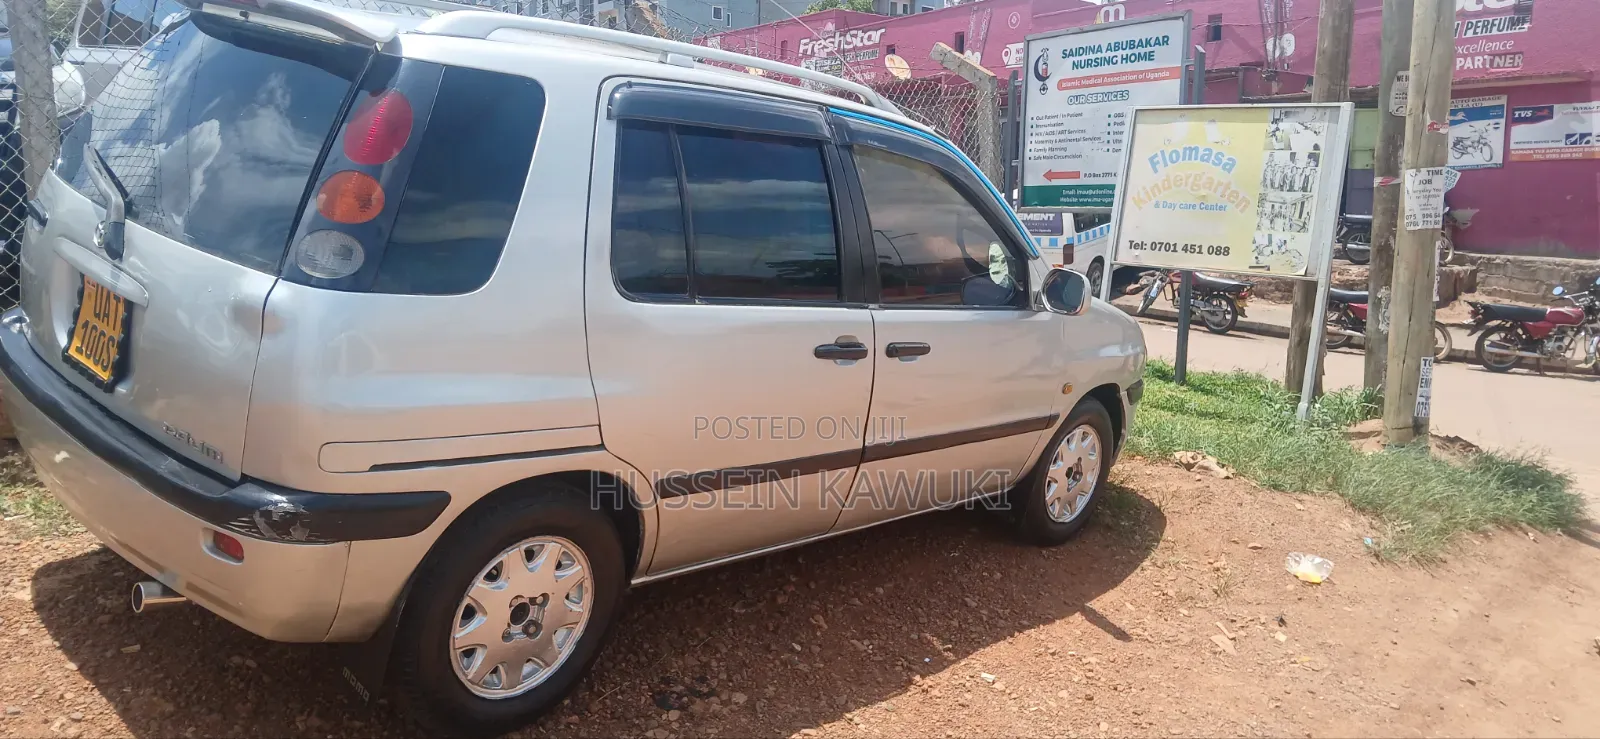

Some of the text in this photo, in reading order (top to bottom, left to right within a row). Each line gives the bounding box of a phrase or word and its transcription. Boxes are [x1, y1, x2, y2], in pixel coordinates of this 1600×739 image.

[1464, 15, 1530, 37] PERFUME
[1061, 35, 1170, 59] SAIDINA ABUBAKAR
[1072, 50, 1155, 71] NURSING HOME
[1456, 54, 1523, 70] PARTNER
[1061, 69, 1170, 88] Islamic Medical Association of Uganda
[1067, 90, 1130, 105] OUR SERVICES
[1514, 110, 1533, 118] TVS
[1147, 145, 1237, 174] Flomasa
[1132, 172, 1251, 214] Kindergarten
[1154, 200, 1227, 211] & Day care Center
[1128, 240, 1230, 256] Tel: 0701 451 088
[94, 283, 121, 331] UAT
[75, 319, 116, 372] 100S
